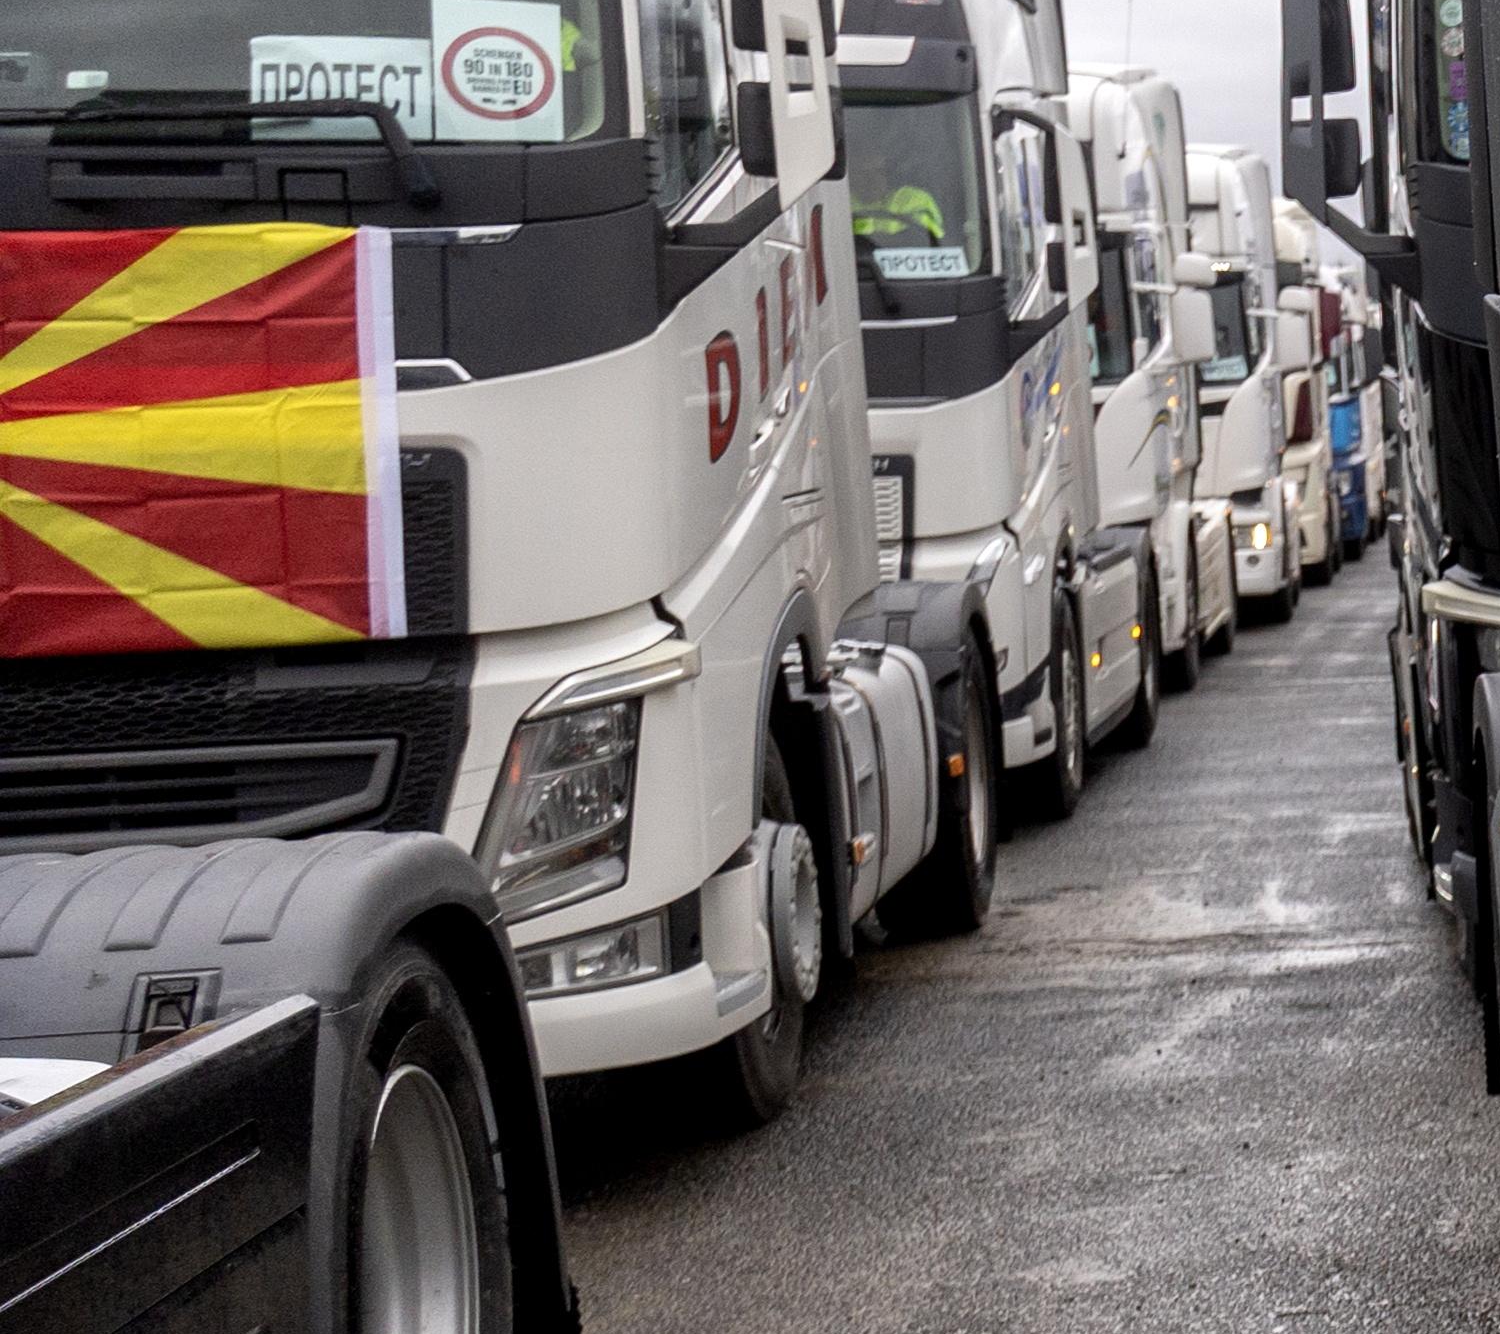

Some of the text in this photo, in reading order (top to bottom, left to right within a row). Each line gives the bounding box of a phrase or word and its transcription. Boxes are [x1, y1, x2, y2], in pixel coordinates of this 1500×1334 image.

[463, 59, 484, 74] 90
[505, 62, 533, 77] 180
[260, 62, 422, 118] ПРОТЕСТ
[513, 80, 532, 96] EU
